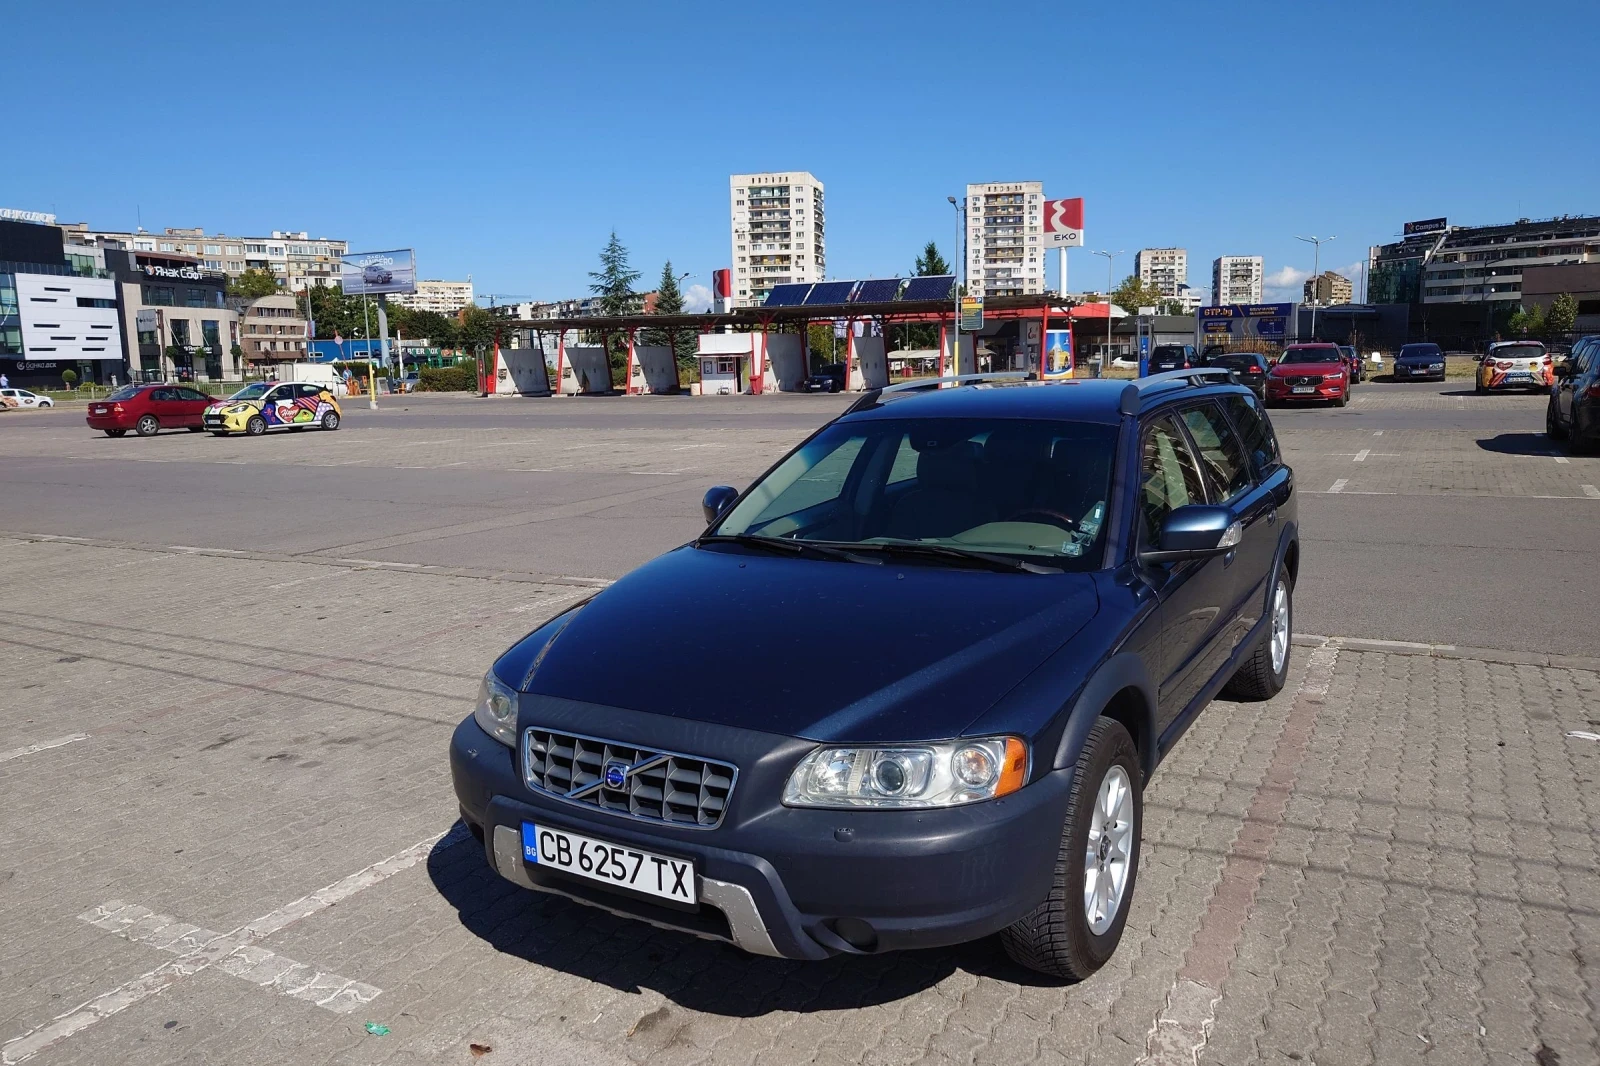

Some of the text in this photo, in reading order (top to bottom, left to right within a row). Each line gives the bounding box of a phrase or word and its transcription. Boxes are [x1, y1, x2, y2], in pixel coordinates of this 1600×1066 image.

[1415, 223, 1439, 231] Campus
[1054, 233, 1076, 241] EKO
[360, 257, 394, 267] SANDERO
[154, 266, 203, 280] Янак Софт
[1204, 308, 1233, 317] GTP.bg
[25, 361, 44, 369] банка
[526, 845, 537, 857] BG
[540, 831, 689, 898] CB 6257 TX
